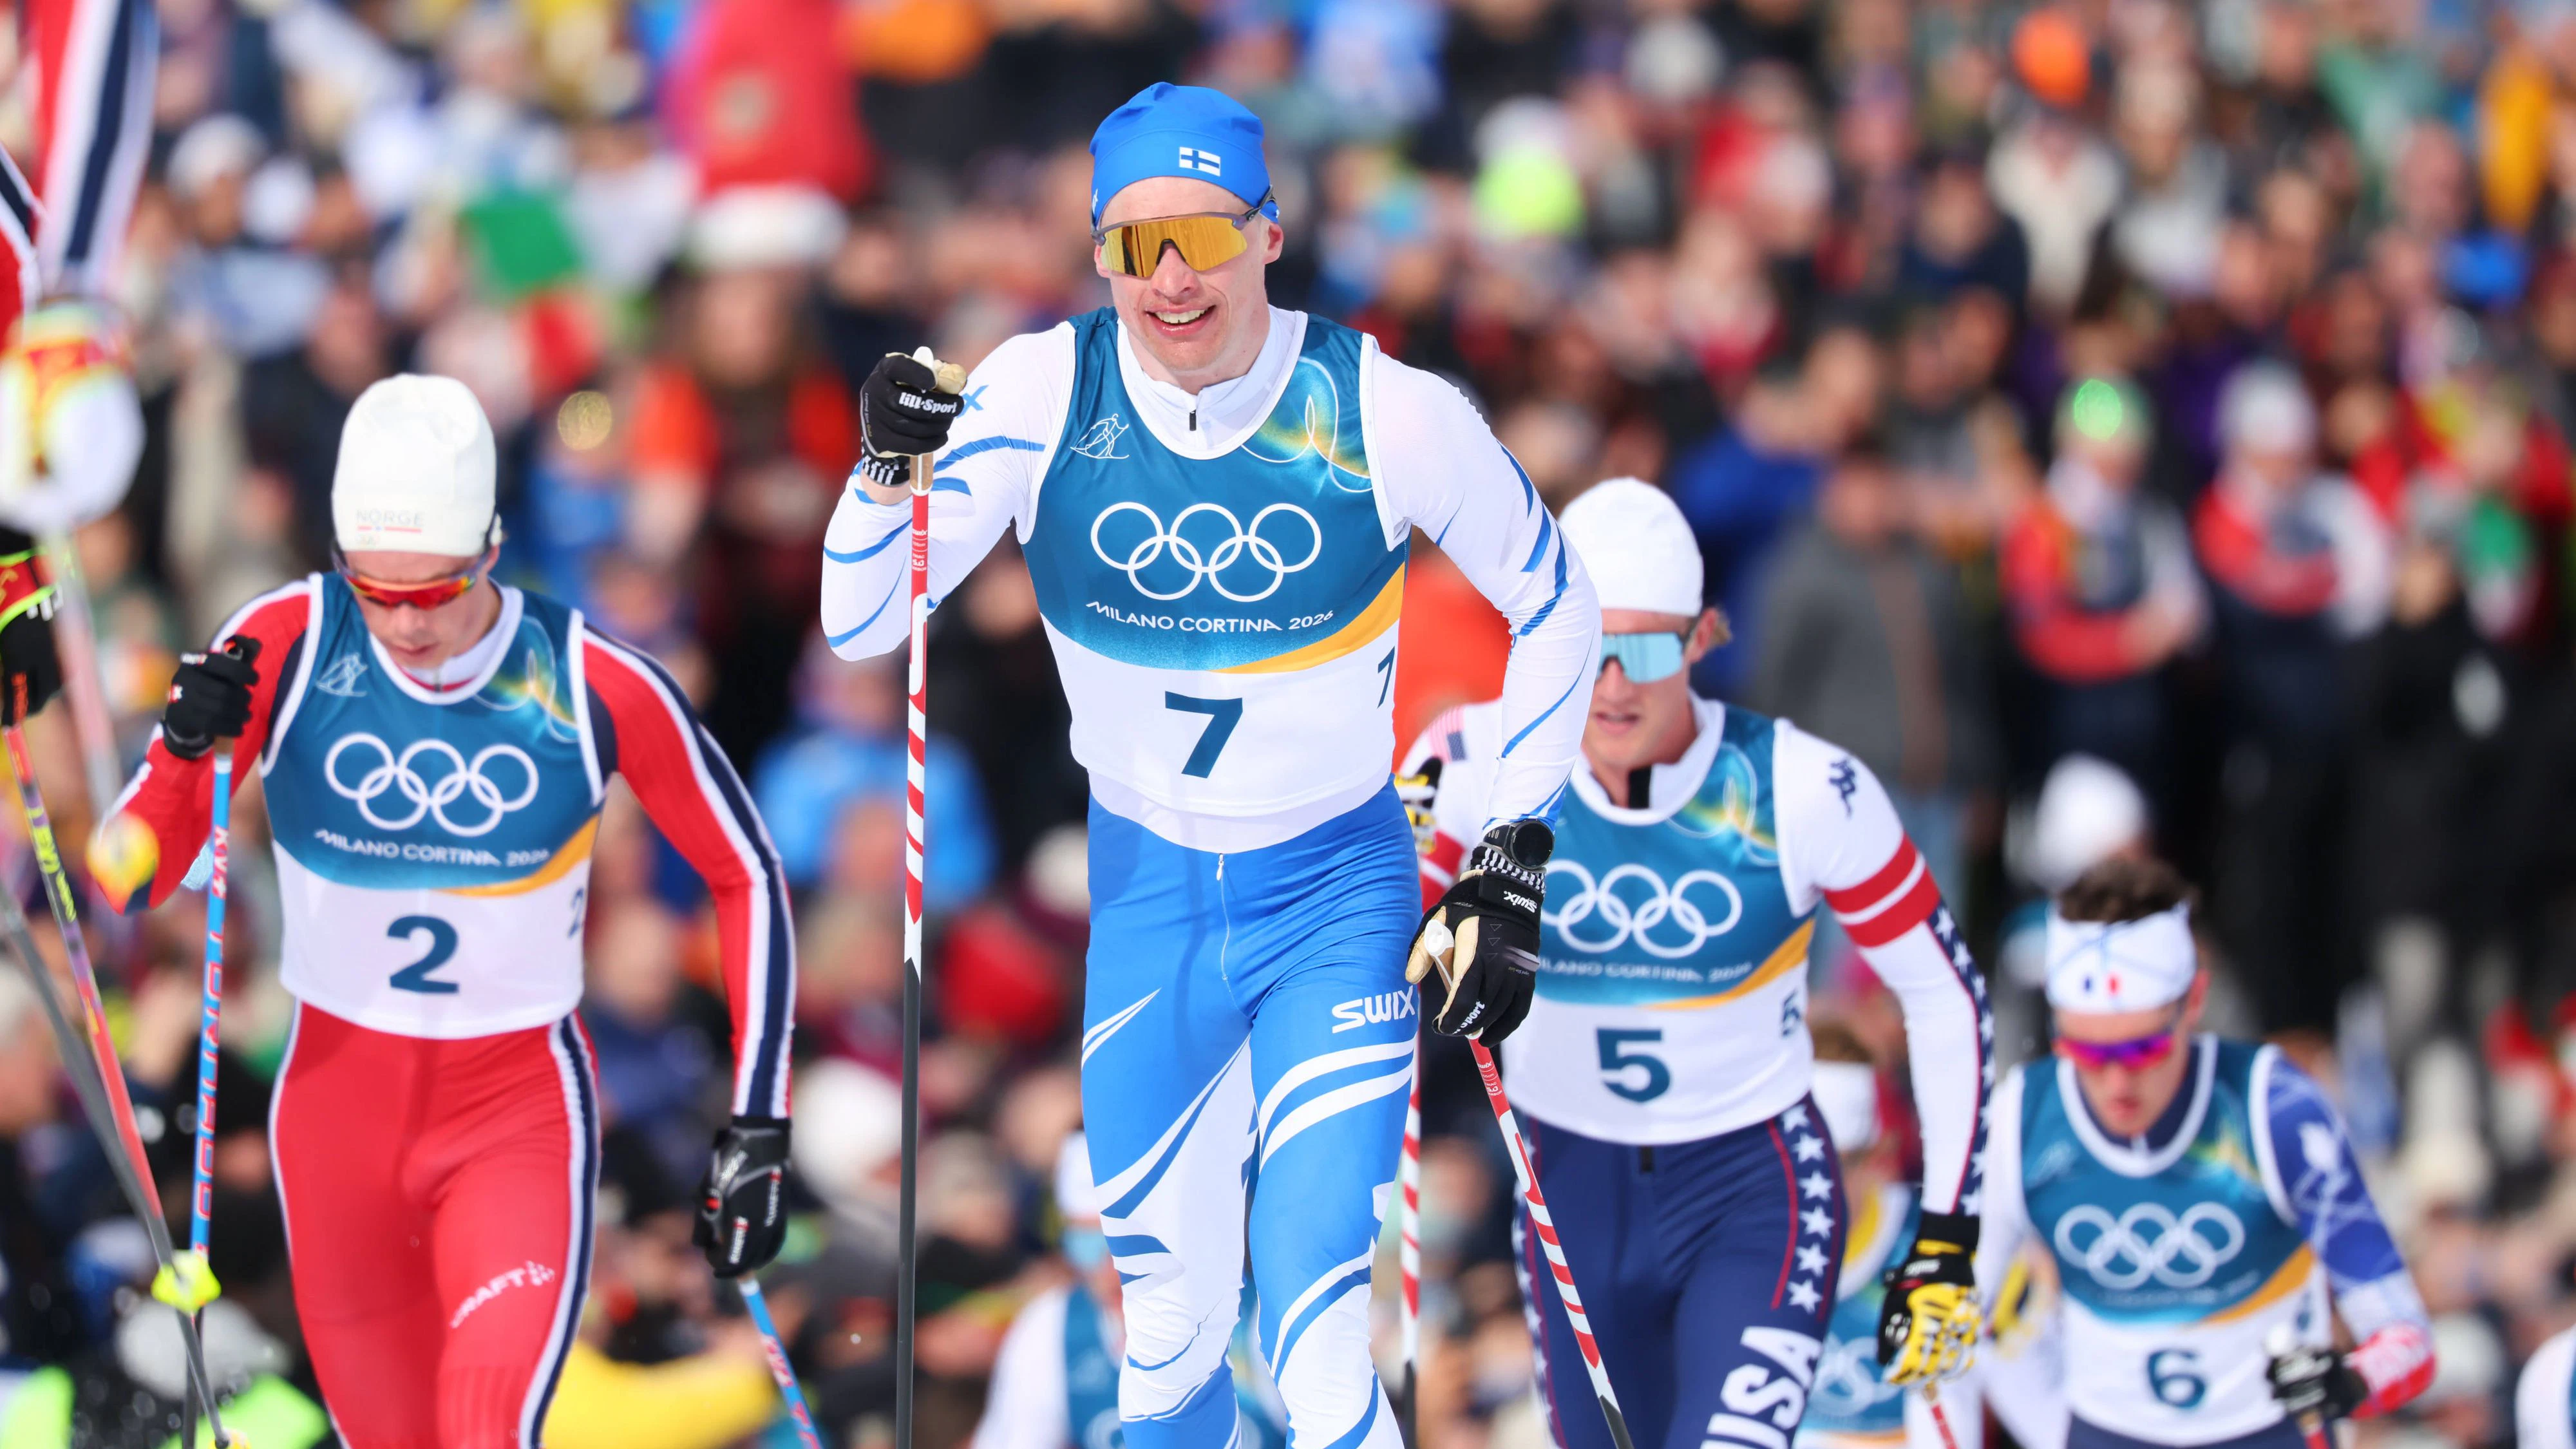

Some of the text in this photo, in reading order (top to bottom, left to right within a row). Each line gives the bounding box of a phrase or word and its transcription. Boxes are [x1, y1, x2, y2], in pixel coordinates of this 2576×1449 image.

[356, 509, 425, 527] NORGE
[1086, 601, 1334, 633] MILANO CORTINA 2026
[1377, 645, 1396, 708] 7
[1164, 690, 1243, 779] 7
[315, 829, 550, 867] MILANO CORTINA 2026
[386, 914, 460, 995] 2
[1540, 958, 1602, 976] ILANO
[1332, 985, 1416, 1034] SWIX
[1595, 1028, 1671, 1104] 5
[2147, 1348, 2208, 1409] 6
